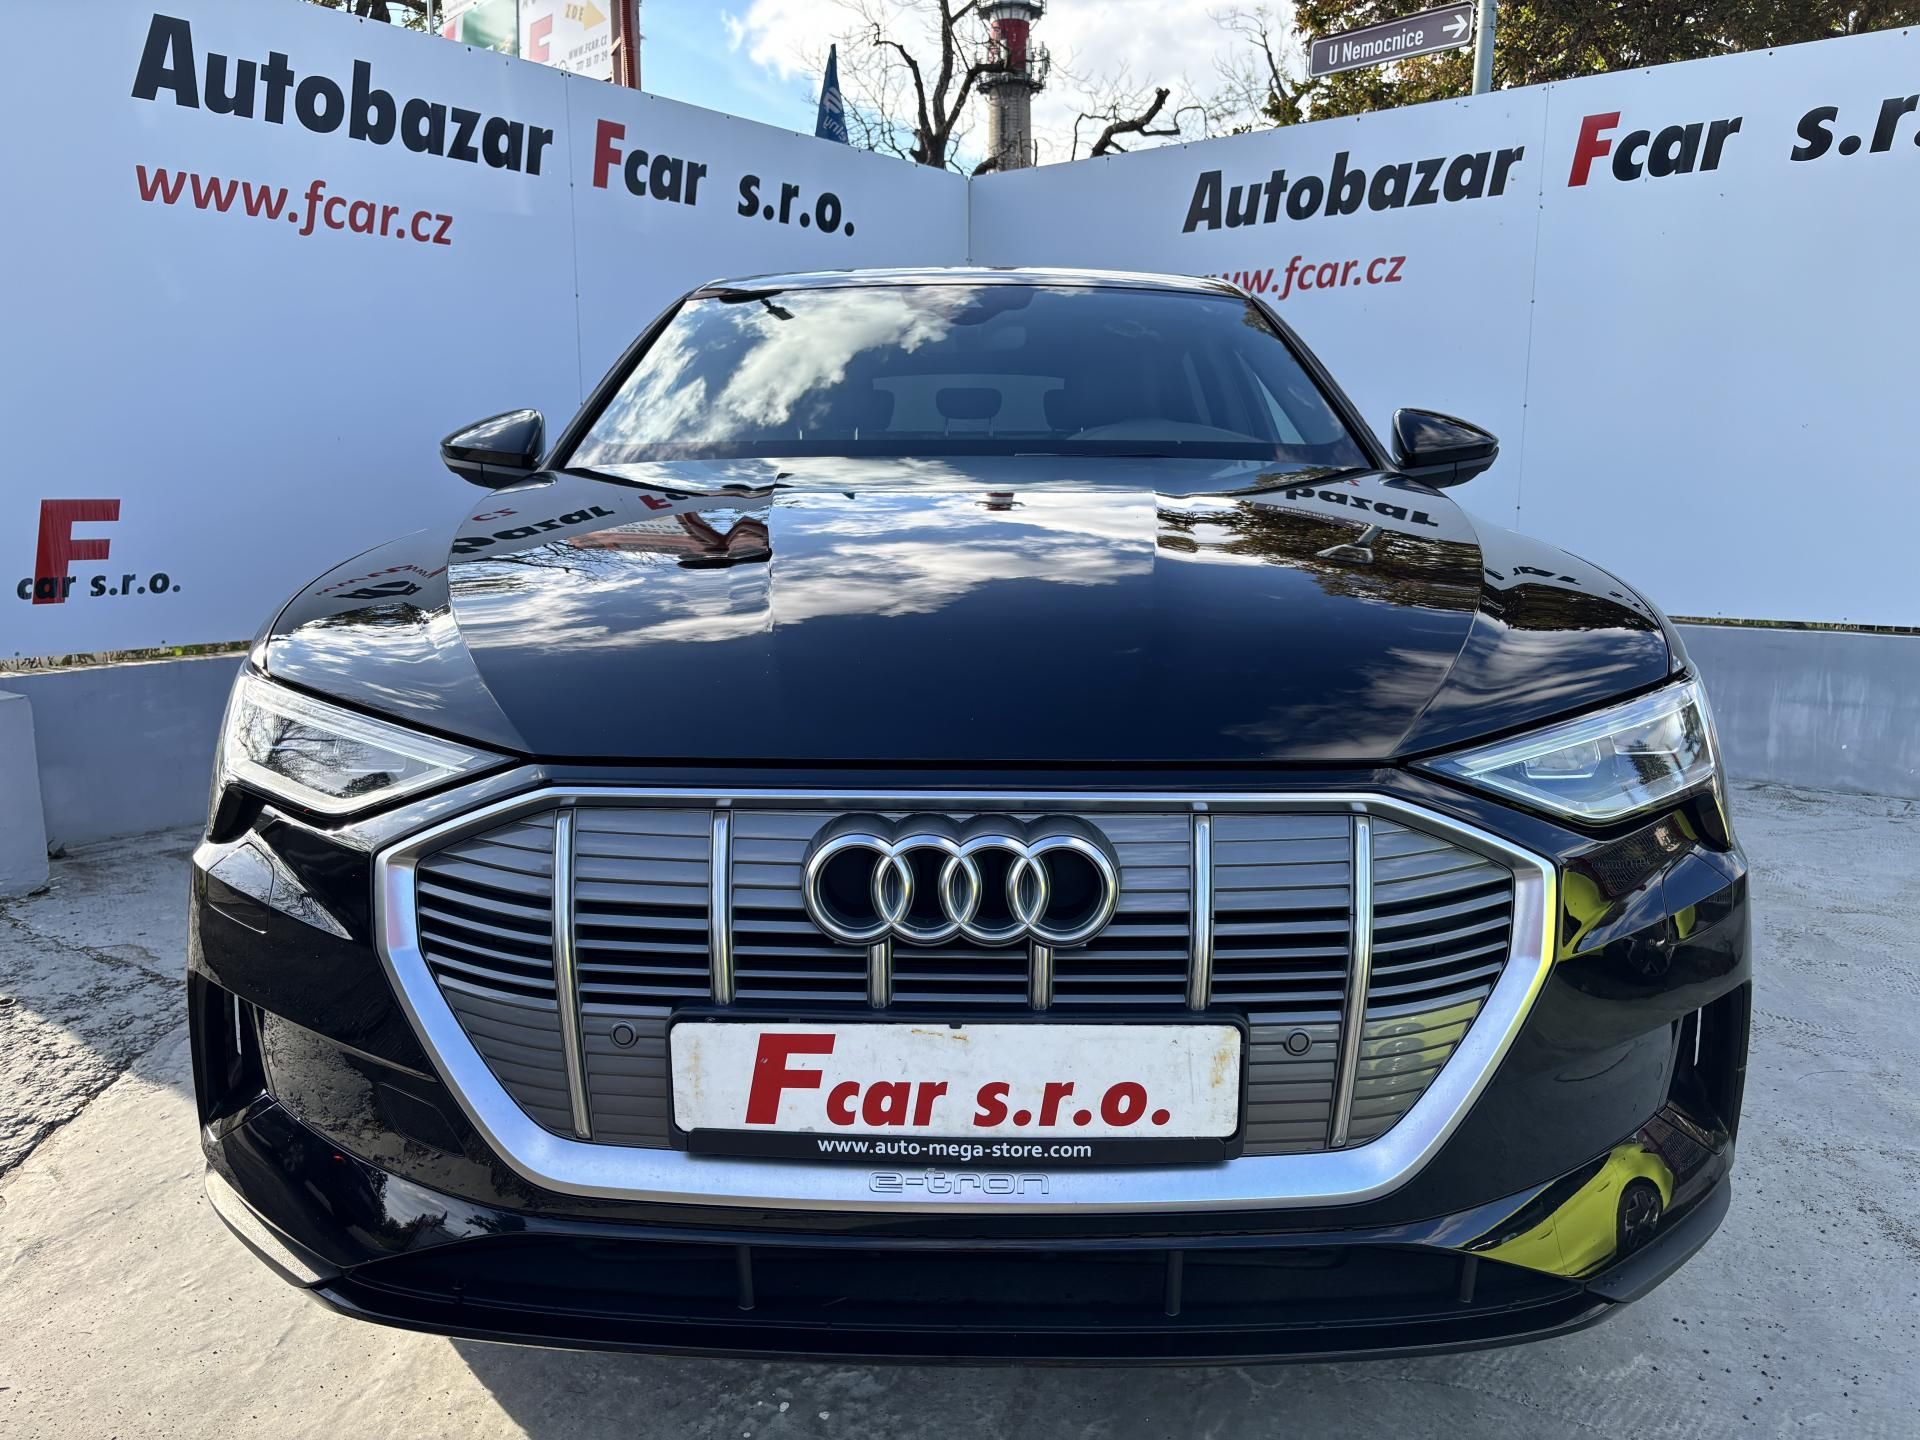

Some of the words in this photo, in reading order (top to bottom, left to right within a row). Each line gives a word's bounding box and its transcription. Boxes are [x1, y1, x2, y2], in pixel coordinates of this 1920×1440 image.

[1328, 44, 1339, 65] U
[1342, 28, 1424, 63] Nemocnice
[132, 13, 554, 177] Autobazar
[593, 119, 708, 207] Fcar
[738, 174, 856, 238] s.r.o.
[1182, 149, 1525, 234] Autobazar
[1567, 111, 1743, 188] Fcar
[136, 165, 453, 246] www.fcar.cz
[90, 572, 182, 598] s.r.o.
[973, 1081, 1172, 1128] s.r.o.
[818, 1139, 1092, 1161] www.auto-mega-store.com
[868, 1167, 1050, 1195] e-tron
